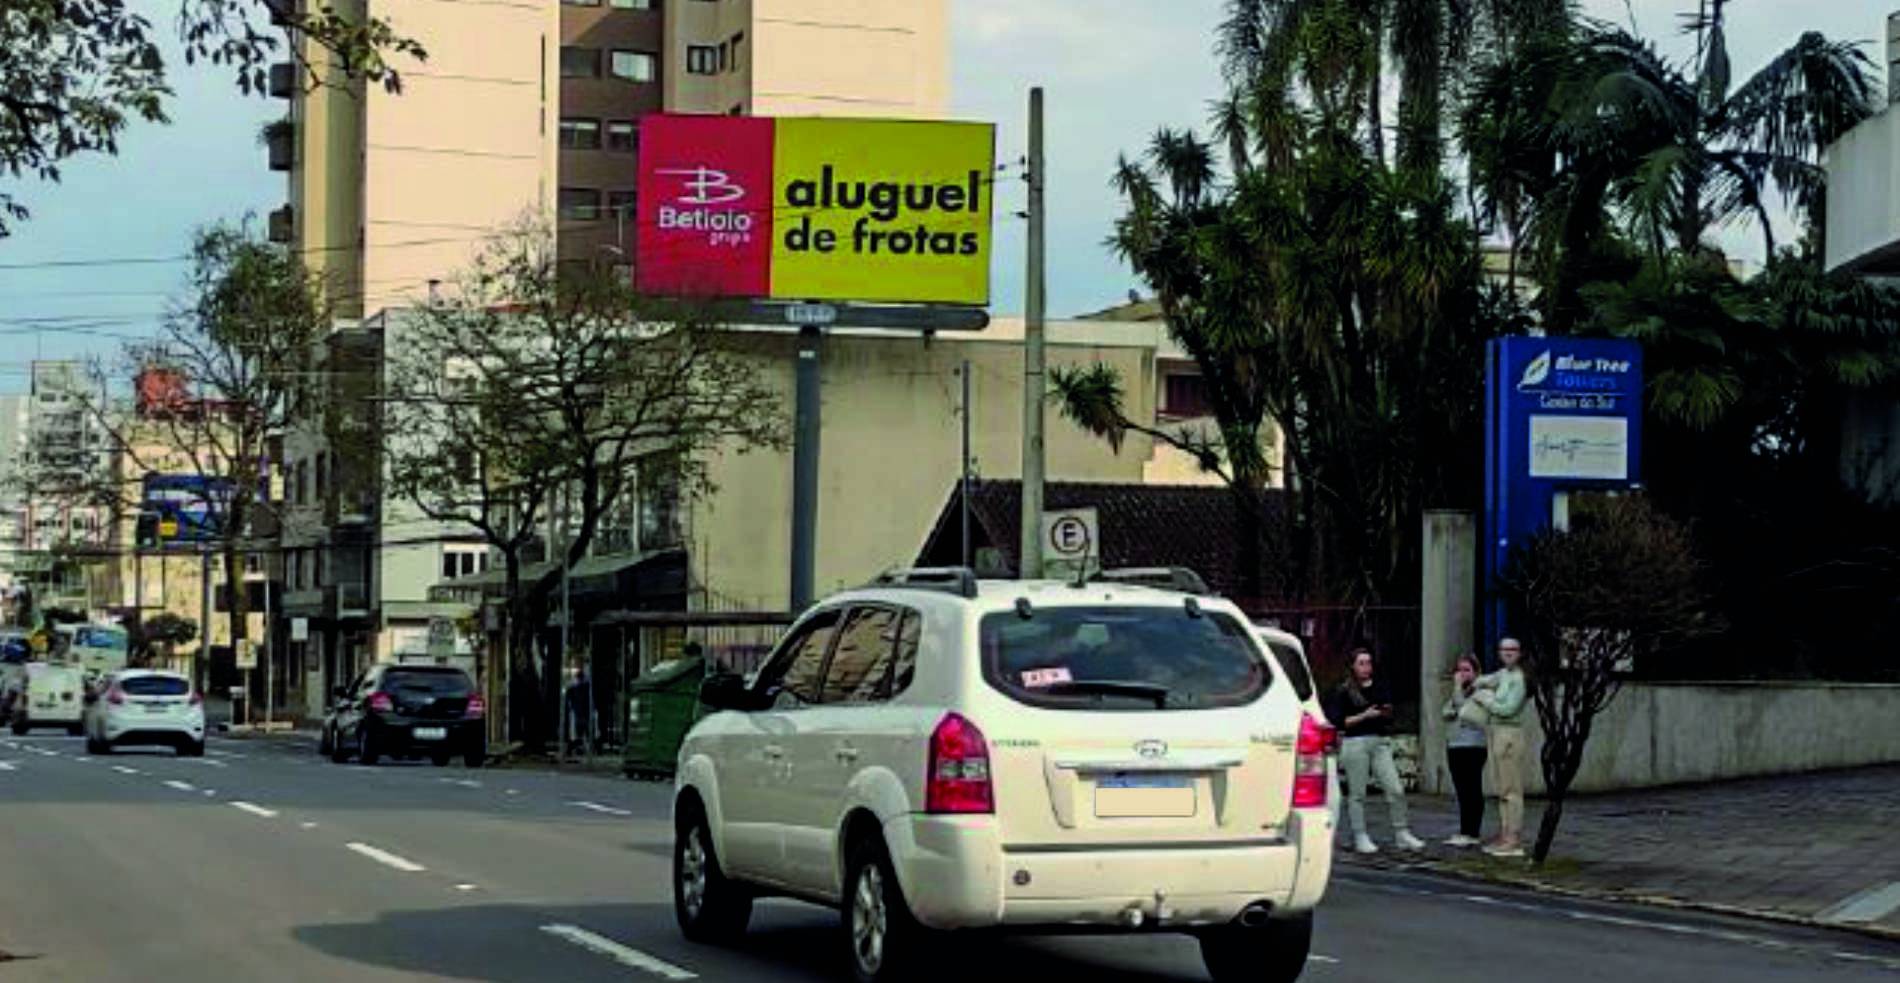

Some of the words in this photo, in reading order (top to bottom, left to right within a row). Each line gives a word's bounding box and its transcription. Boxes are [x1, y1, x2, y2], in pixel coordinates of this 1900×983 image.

[786, 164, 980, 222] aluguel
[784, 216, 836, 253] de
[853, 217, 979, 255] frotas
[1062, 522, 1077, 548] E
